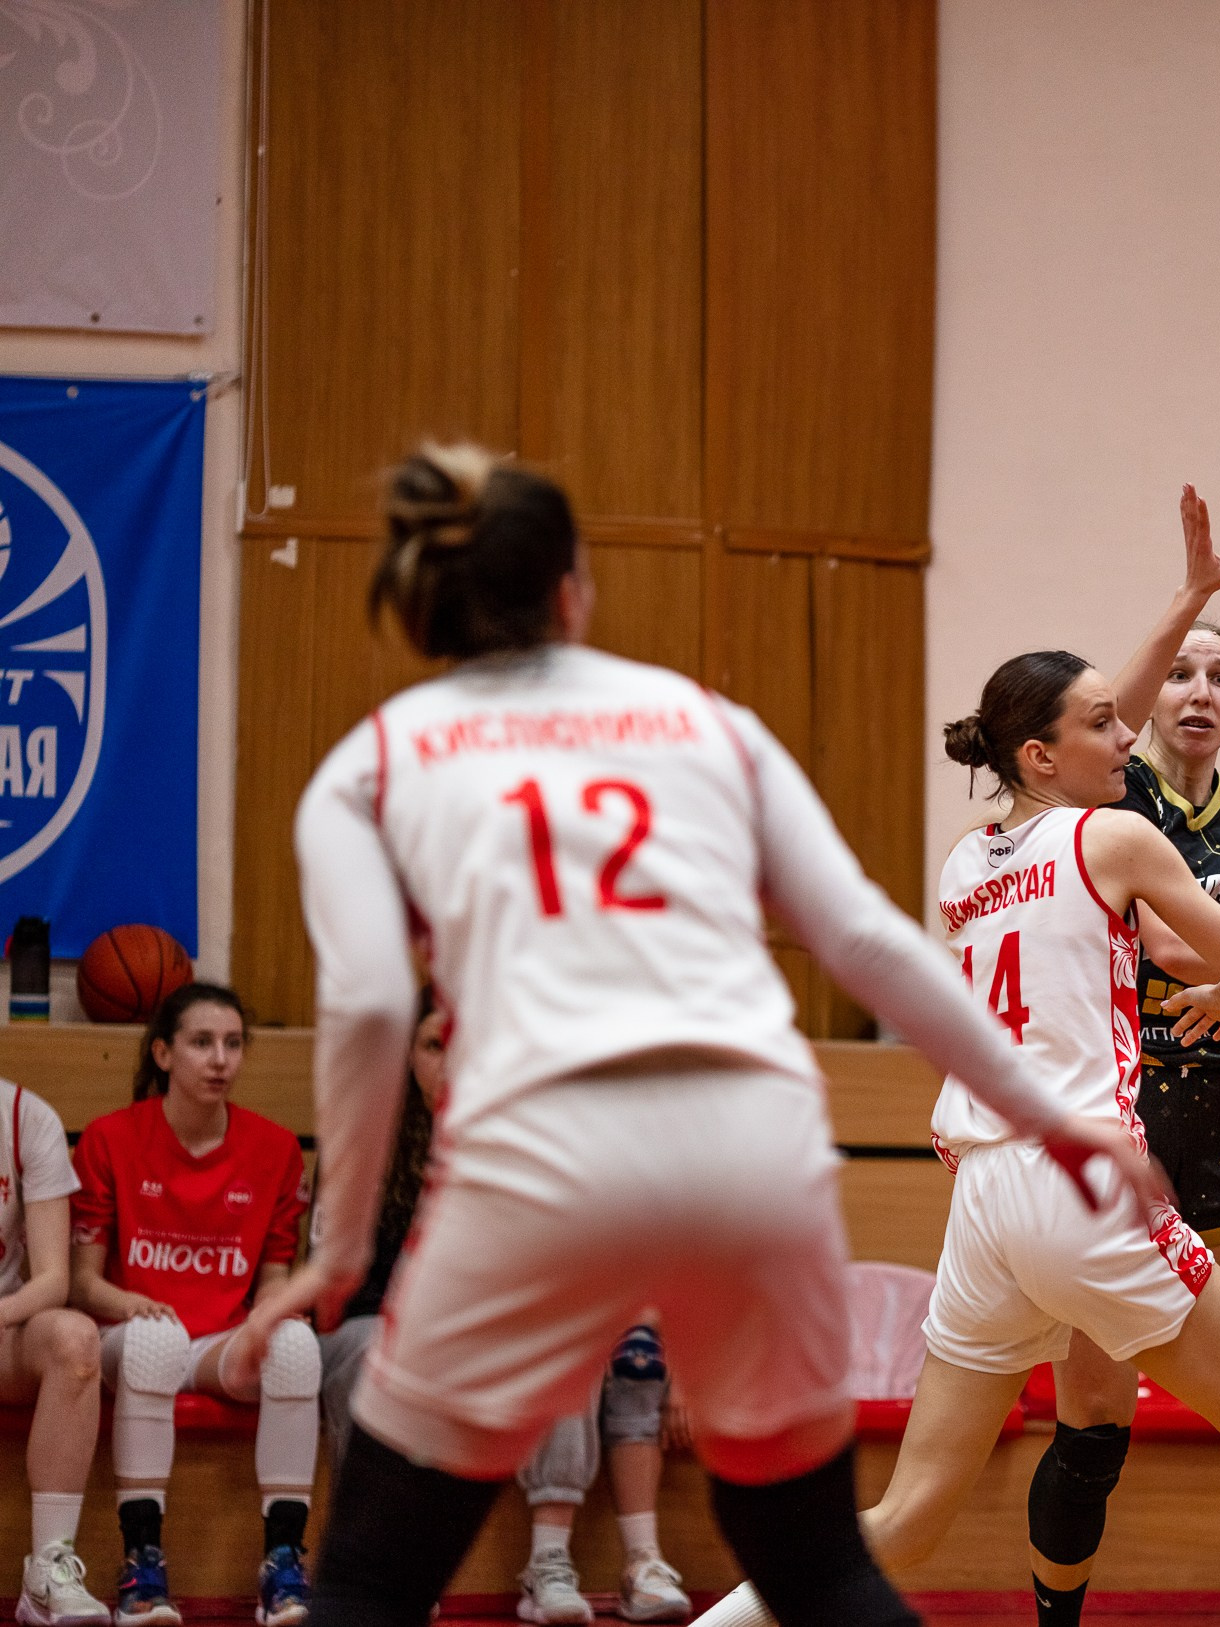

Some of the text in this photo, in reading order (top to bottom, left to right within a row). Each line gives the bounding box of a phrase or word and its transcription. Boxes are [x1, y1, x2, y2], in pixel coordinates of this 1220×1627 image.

[500, 774, 668, 919] 12
[989, 846, 1012, 857] РФБ
[127, 1236, 249, 1277] ЮНОСТЬ
[1192, 1262, 1210, 1284] SPOR
